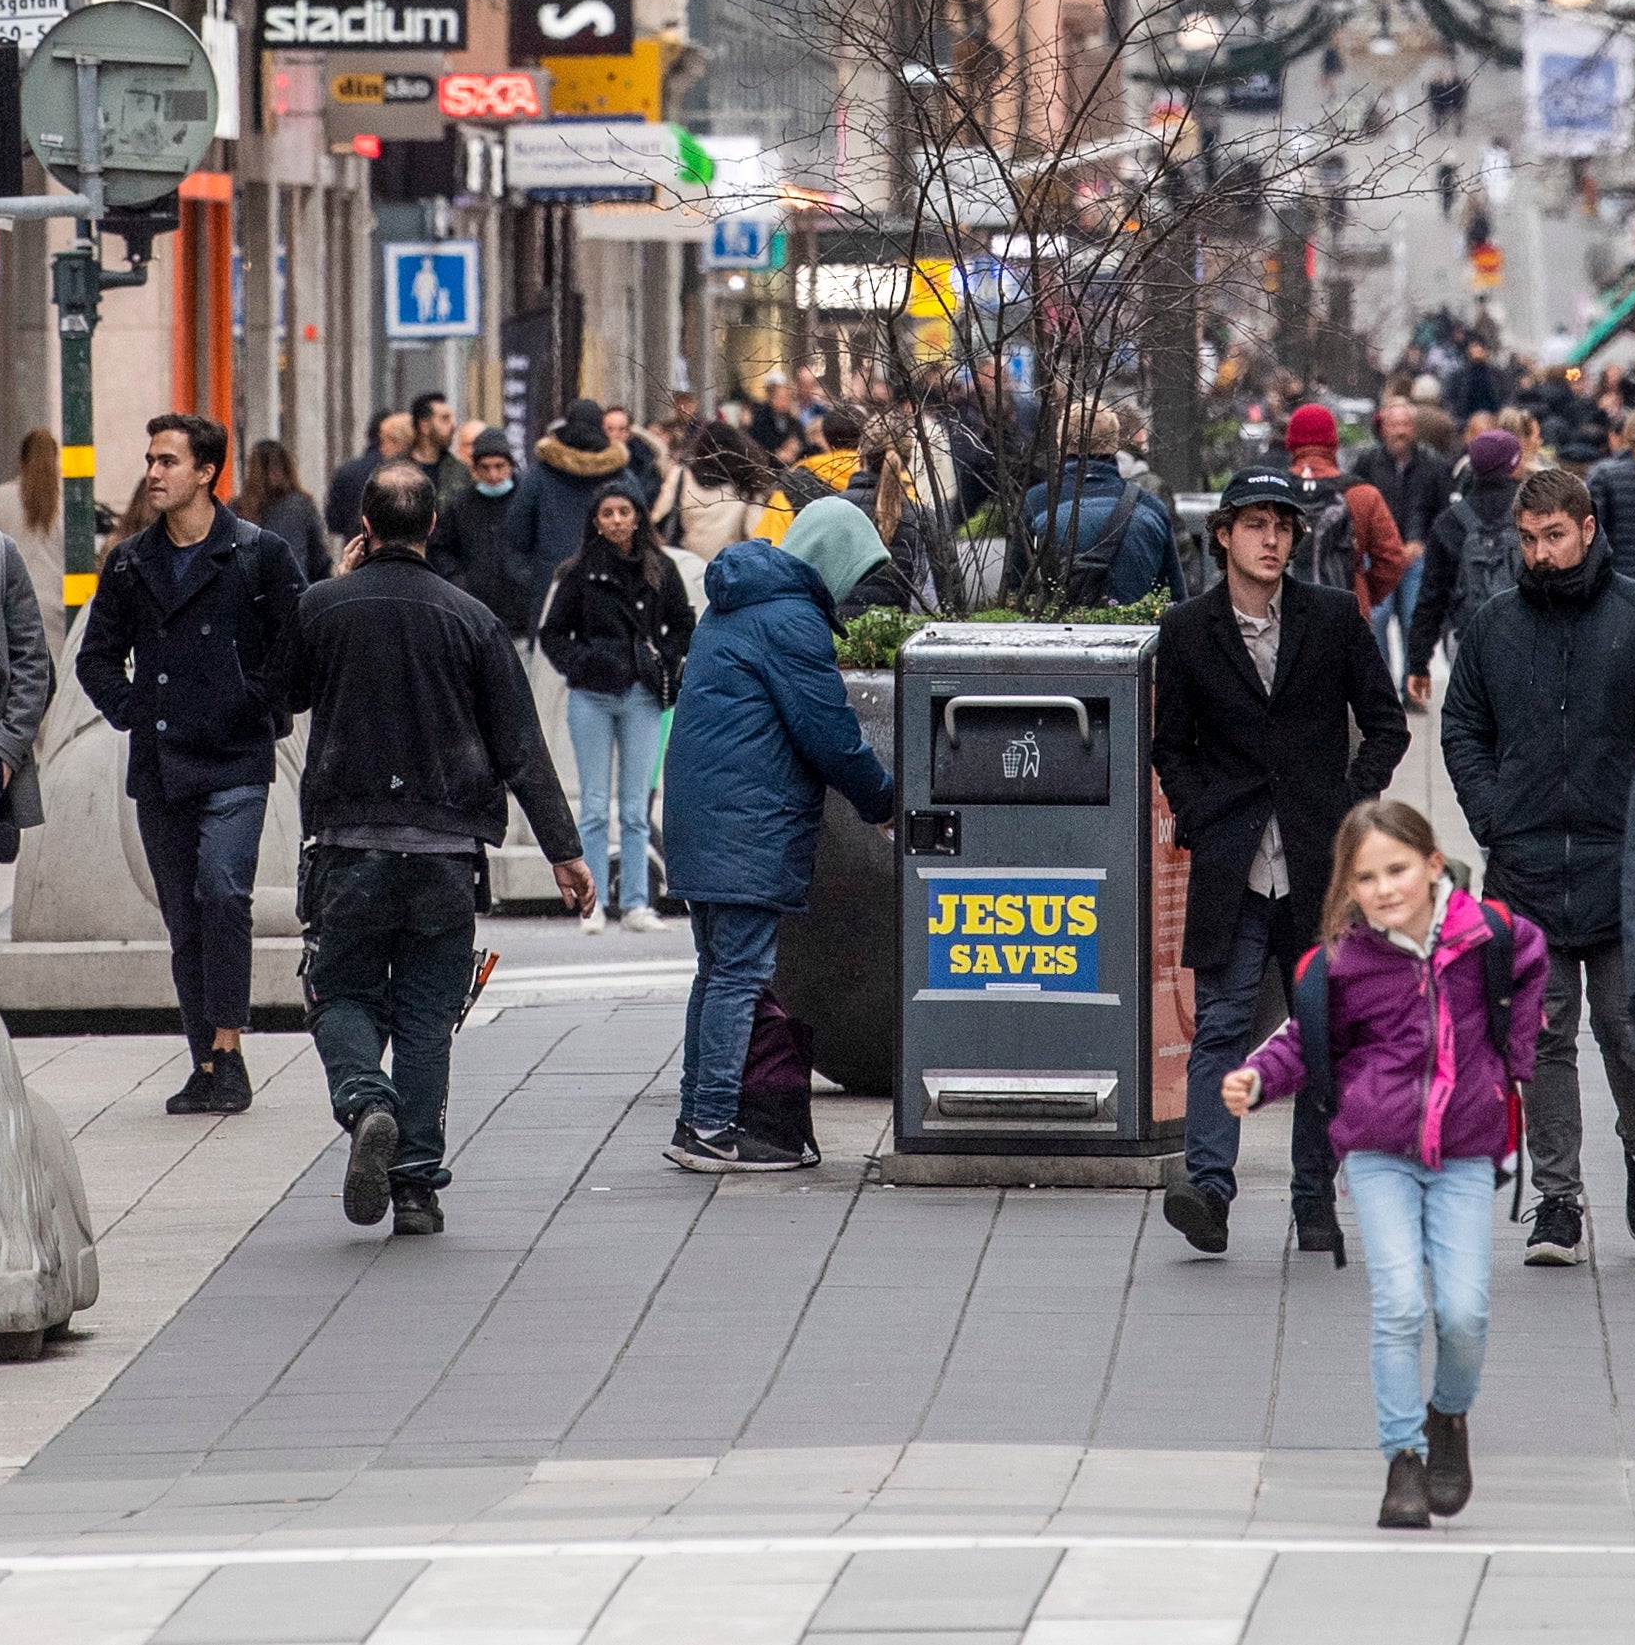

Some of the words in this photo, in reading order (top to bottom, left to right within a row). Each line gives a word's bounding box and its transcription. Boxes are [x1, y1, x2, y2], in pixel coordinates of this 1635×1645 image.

[264, 0, 459, 44] stadium
[928, 894, 1098, 936] JESUS
[950, 945, 1078, 975] SAVES
